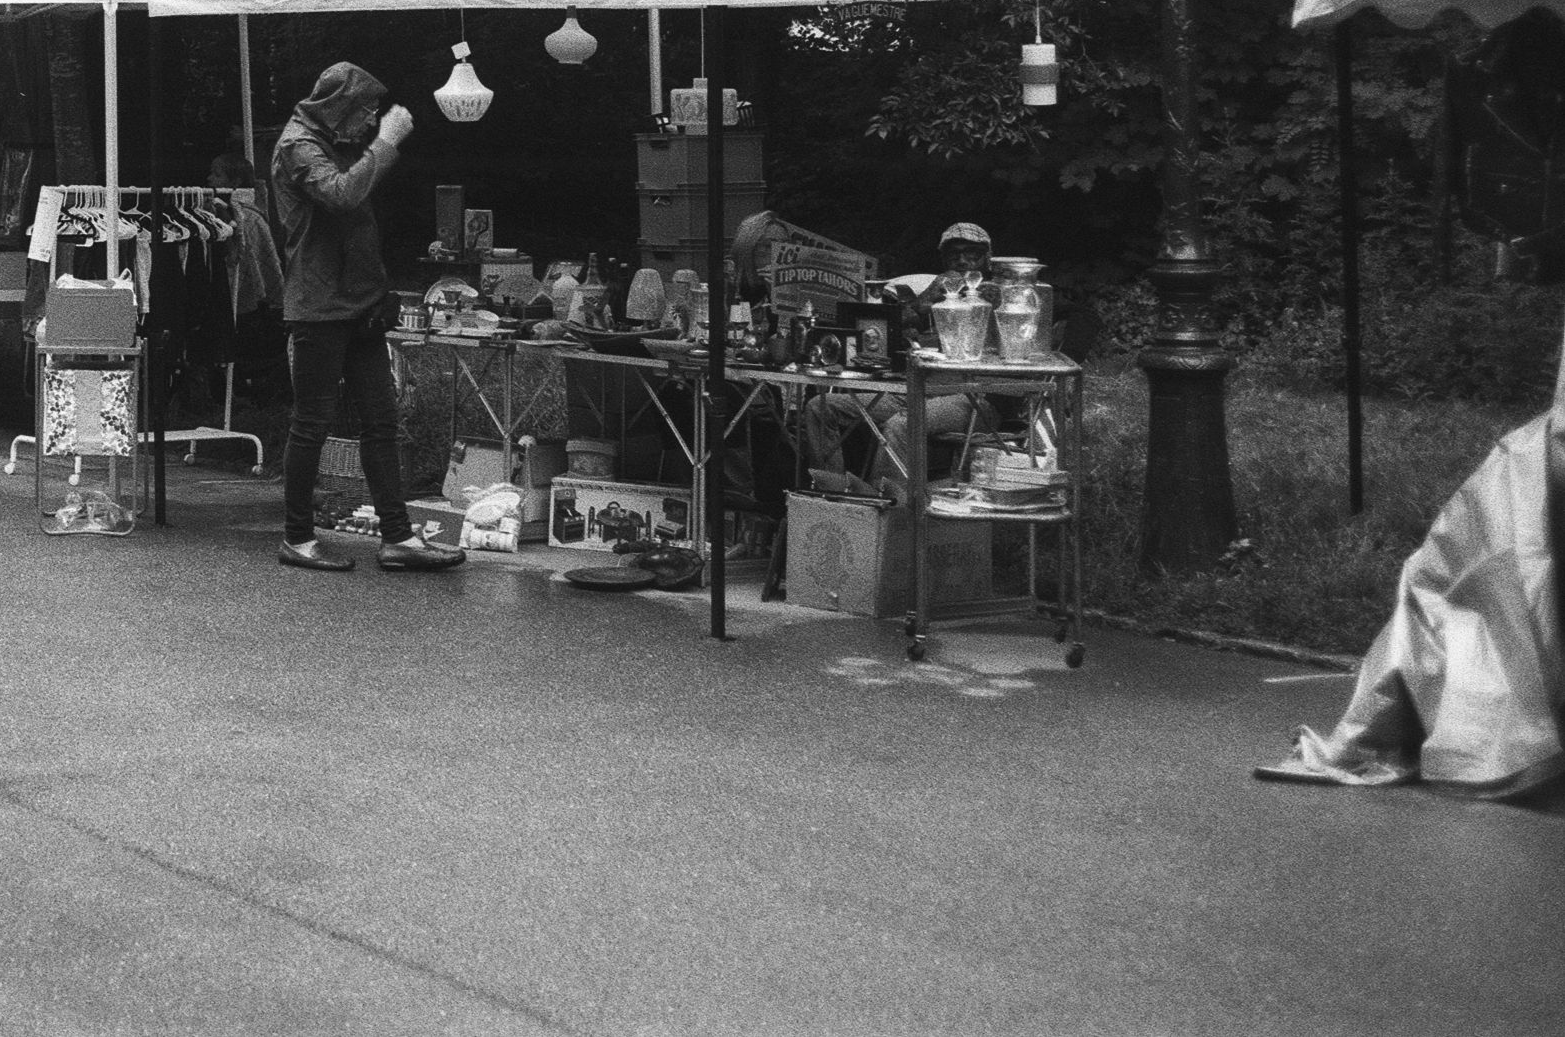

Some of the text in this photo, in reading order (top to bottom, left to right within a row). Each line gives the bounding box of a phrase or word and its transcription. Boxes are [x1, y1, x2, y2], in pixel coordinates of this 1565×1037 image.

[776, 245, 800, 265] ici
[778, 268, 796, 283] TIP
[797, 268, 817, 282] TOP
[818, 269, 858, 296] TAILORS
